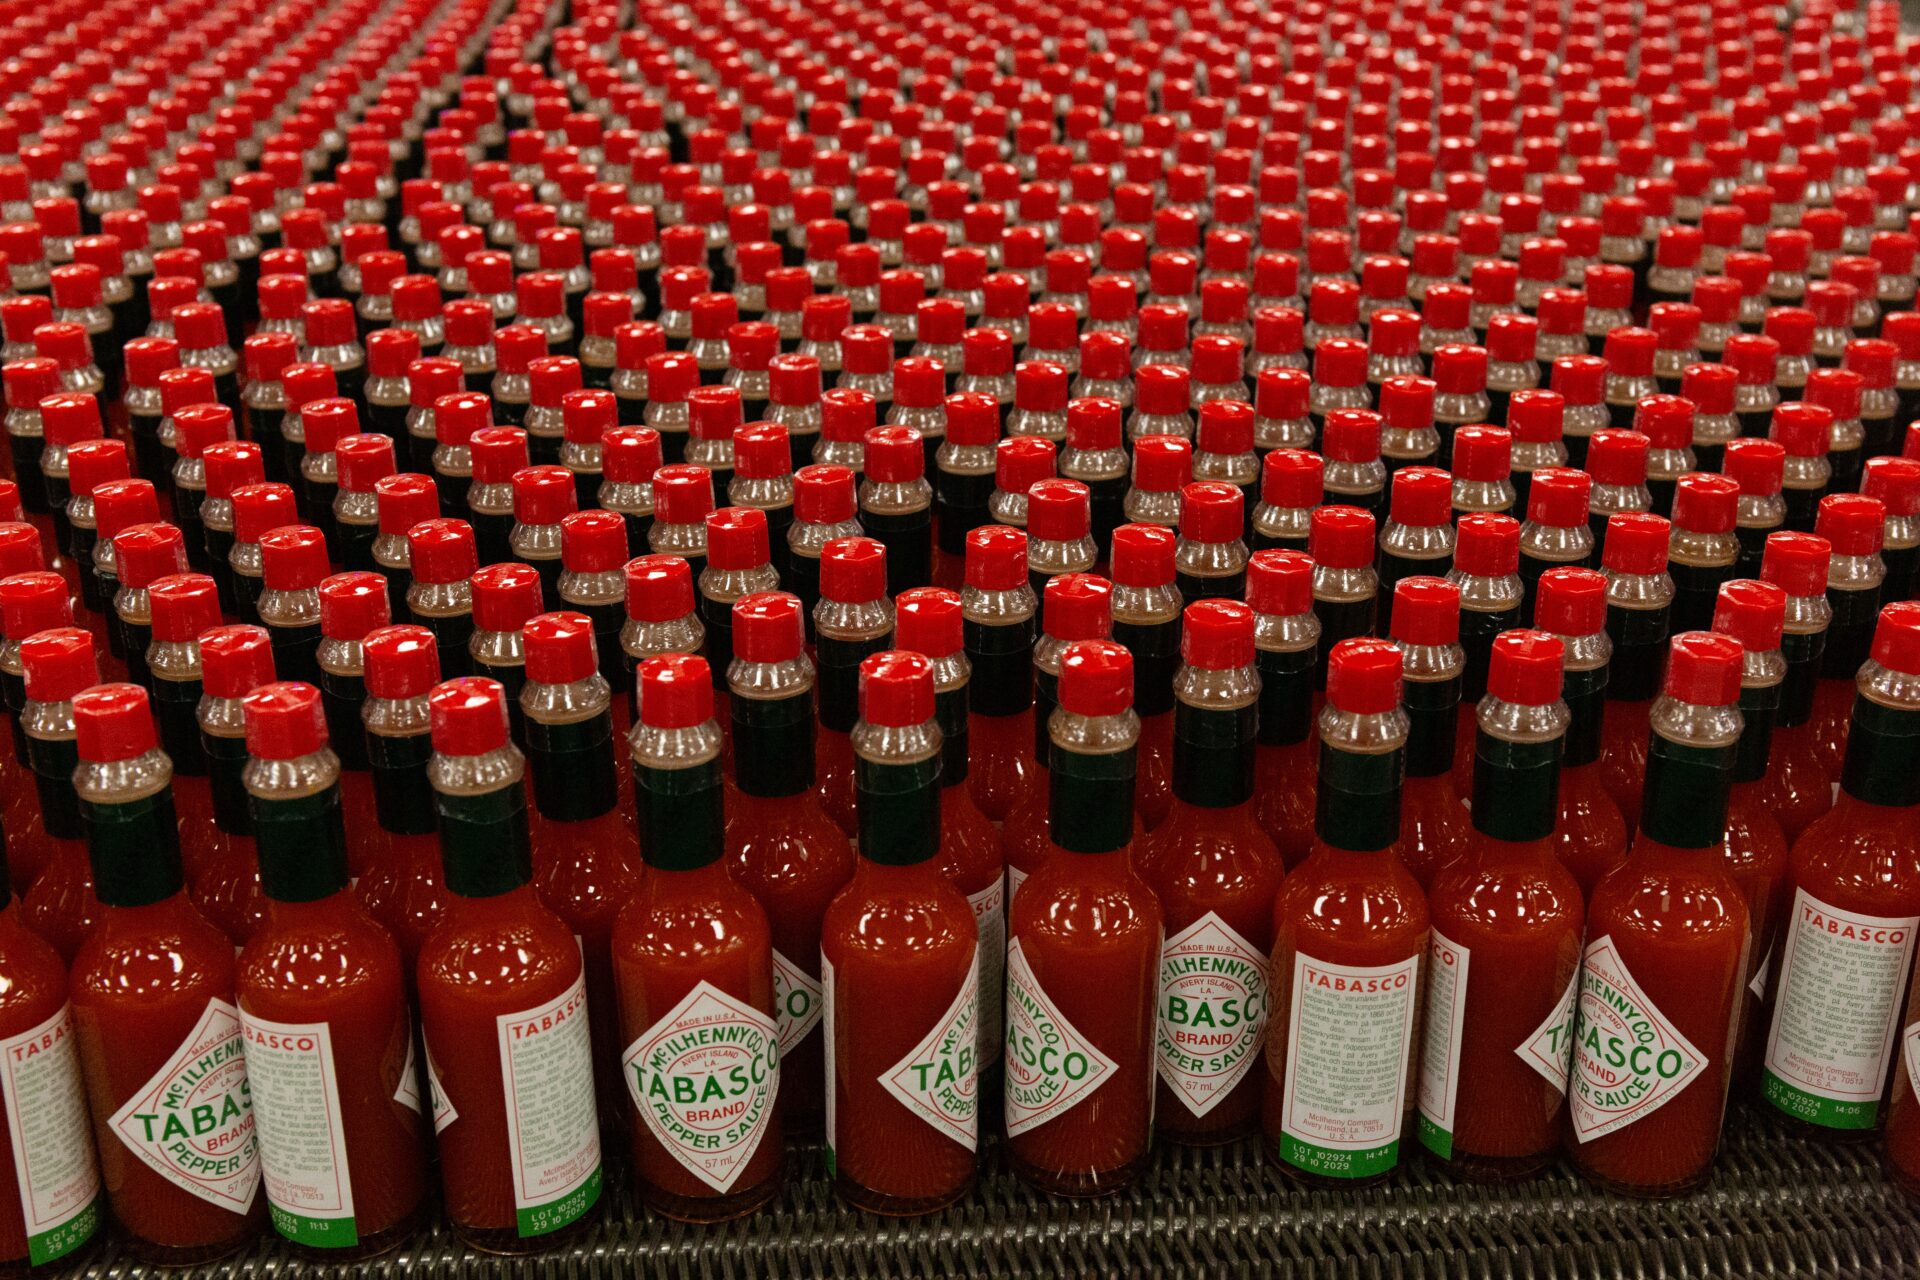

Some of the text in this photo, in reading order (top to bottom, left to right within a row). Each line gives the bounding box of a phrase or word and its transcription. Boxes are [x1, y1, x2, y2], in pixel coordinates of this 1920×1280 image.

[1804, 907, 1905, 945] TABASCO
[1180, 944, 1204, 952] MADE
[1180, 978, 1235, 993] AVERY ISLAND
[1307, 969, 1407, 993] TABASCO
[512, 984, 586, 1040] TABASCO
[675, 1017, 700, 1029] MADE
[703, 1014, 713, 1023] IN
[191, 1038, 215, 1057] MADE
[243, 1024, 314, 1052] BASCO
[1175, 1030, 1233, 1046] BRAND
[1209, 1023, 1258, 1072] SAUCE
[681, 1049, 739, 1067] AVERY ISLAND
[704, 1059, 719, 1068] LA.
[1783, 1056, 1801, 1072] Avery
[631, 1038, 778, 1104] TABASCO
[1825, 1065, 1860, 1078] Company
[199, 1071, 222, 1094] AVERY
[1015, 1076, 1060, 1104] SAUCE
[1185, 1081, 1199, 1090] 57
[1593, 1076, 1651, 1107] SAUCE
[1767, 1087, 1818, 1117] 29 10 2029
[1768, 1079, 1783, 1093] LOT
[1787, 1090, 1822, 1110] 102924
[653, 1102, 721, 1149] PEPPER
[726, 1083, 768, 1143] SAUCE
[686, 1101, 745, 1122] BRAND
[206, 1113, 256, 1151] BRAND
[1302, 1118, 1322, 1130] Avery
[1347, 1118, 1379, 1128] Company
[167, 1141, 240, 1176] PEPPER
[1293, 1143, 1311, 1156] LOT
[1316, 1151, 1352, 1161] 102924
[1293, 1153, 1350, 1170] 29 10 2029
[705, 1155, 736, 1169] 57 mL
[227, 1182, 238, 1194] 57
[538, 1174, 559, 1187] Avery
[531, 1190, 586, 1222] LOT 102924
[533, 1199, 586, 1231] 29 10 2029
[46, 1229, 66, 1246] LOT
[48, 1234, 76, 1254] 29 10
